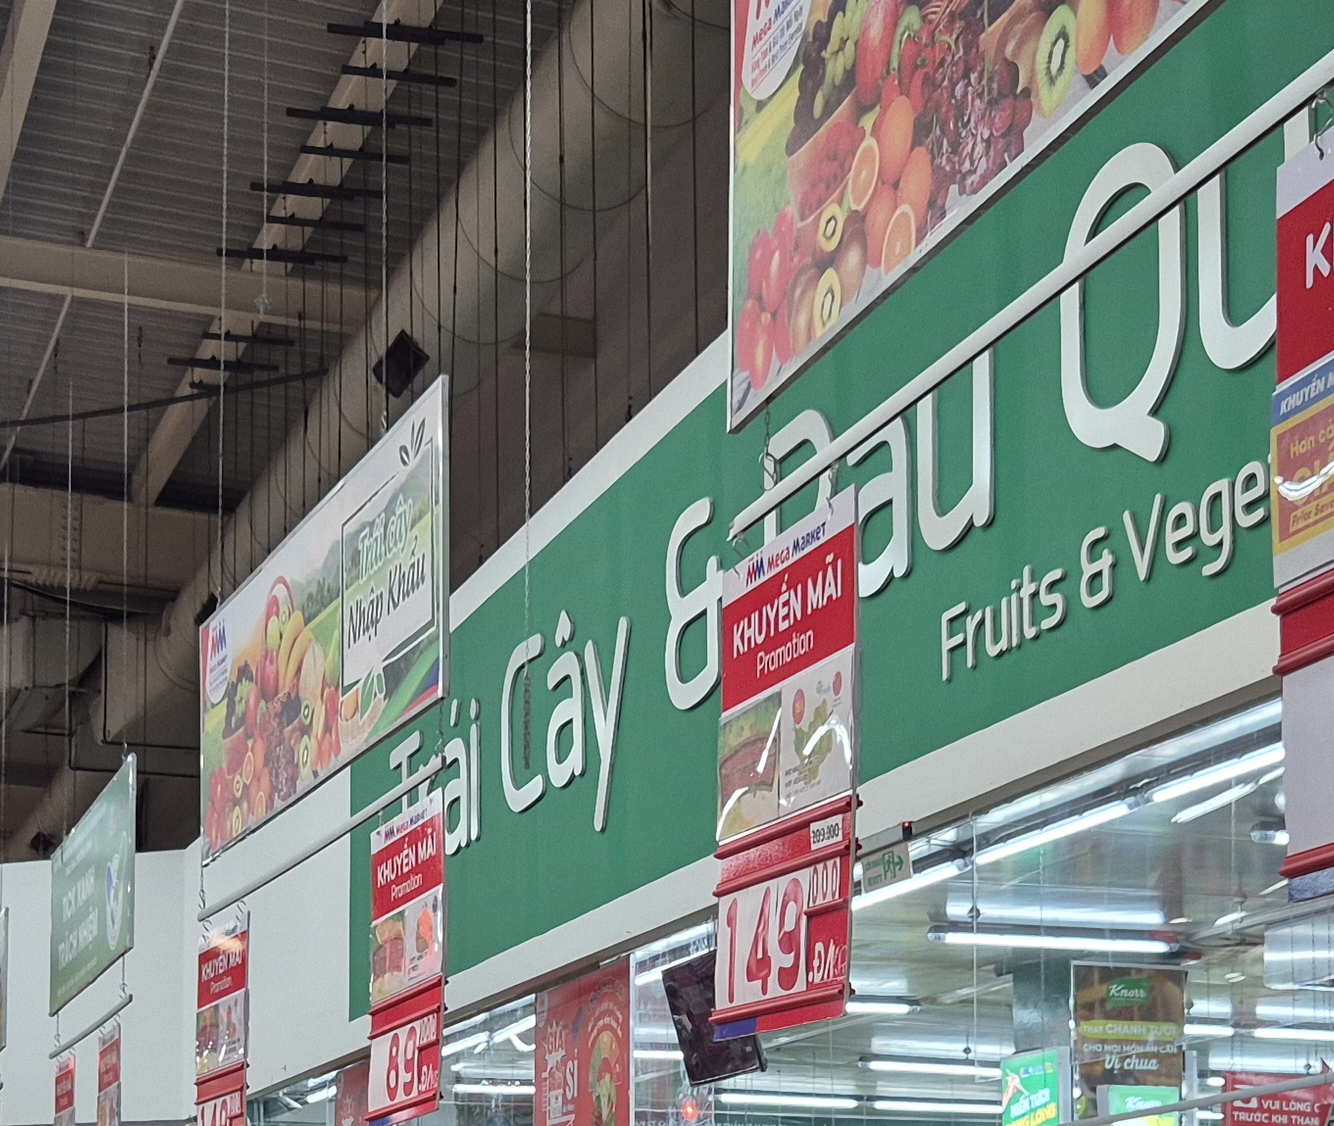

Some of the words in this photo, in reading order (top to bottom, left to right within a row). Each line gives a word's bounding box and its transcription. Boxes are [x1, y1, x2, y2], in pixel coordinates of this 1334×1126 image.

[348, 588, 384, 650] Nhập
[386, 534, 427, 617] Khẩu
[938, 559, 1065, 678] Fruits
[1078, 523, 1114, 606] &
[1122, 455, 1270, 580] Vege
[732, 572, 803, 659] KHUYẾN
[806, 552, 843, 616] MÃI
[499, 609, 632, 833] Cây
[665, 497, 724, 712] &
[756, 628, 815, 680] Promotion
[377, 837, 416, 888] KHUYẾN
[417, 826, 437, 866] MÃI
[390, 872, 423, 903] Promotion
[726, 877, 804, 1005] 149
[811, 859, 839, 905] 000
[1108, 983, 1148, 999] Knorr
[1105, 1023, 1147, 1035] CHANH
[385, 1026, 417, 1102] 89
[1123, 1055, 1160, 1070] chua
[1261, 1099, 1282, 1110] VUI
[1271, 1112, 1289, 1125] KHI
